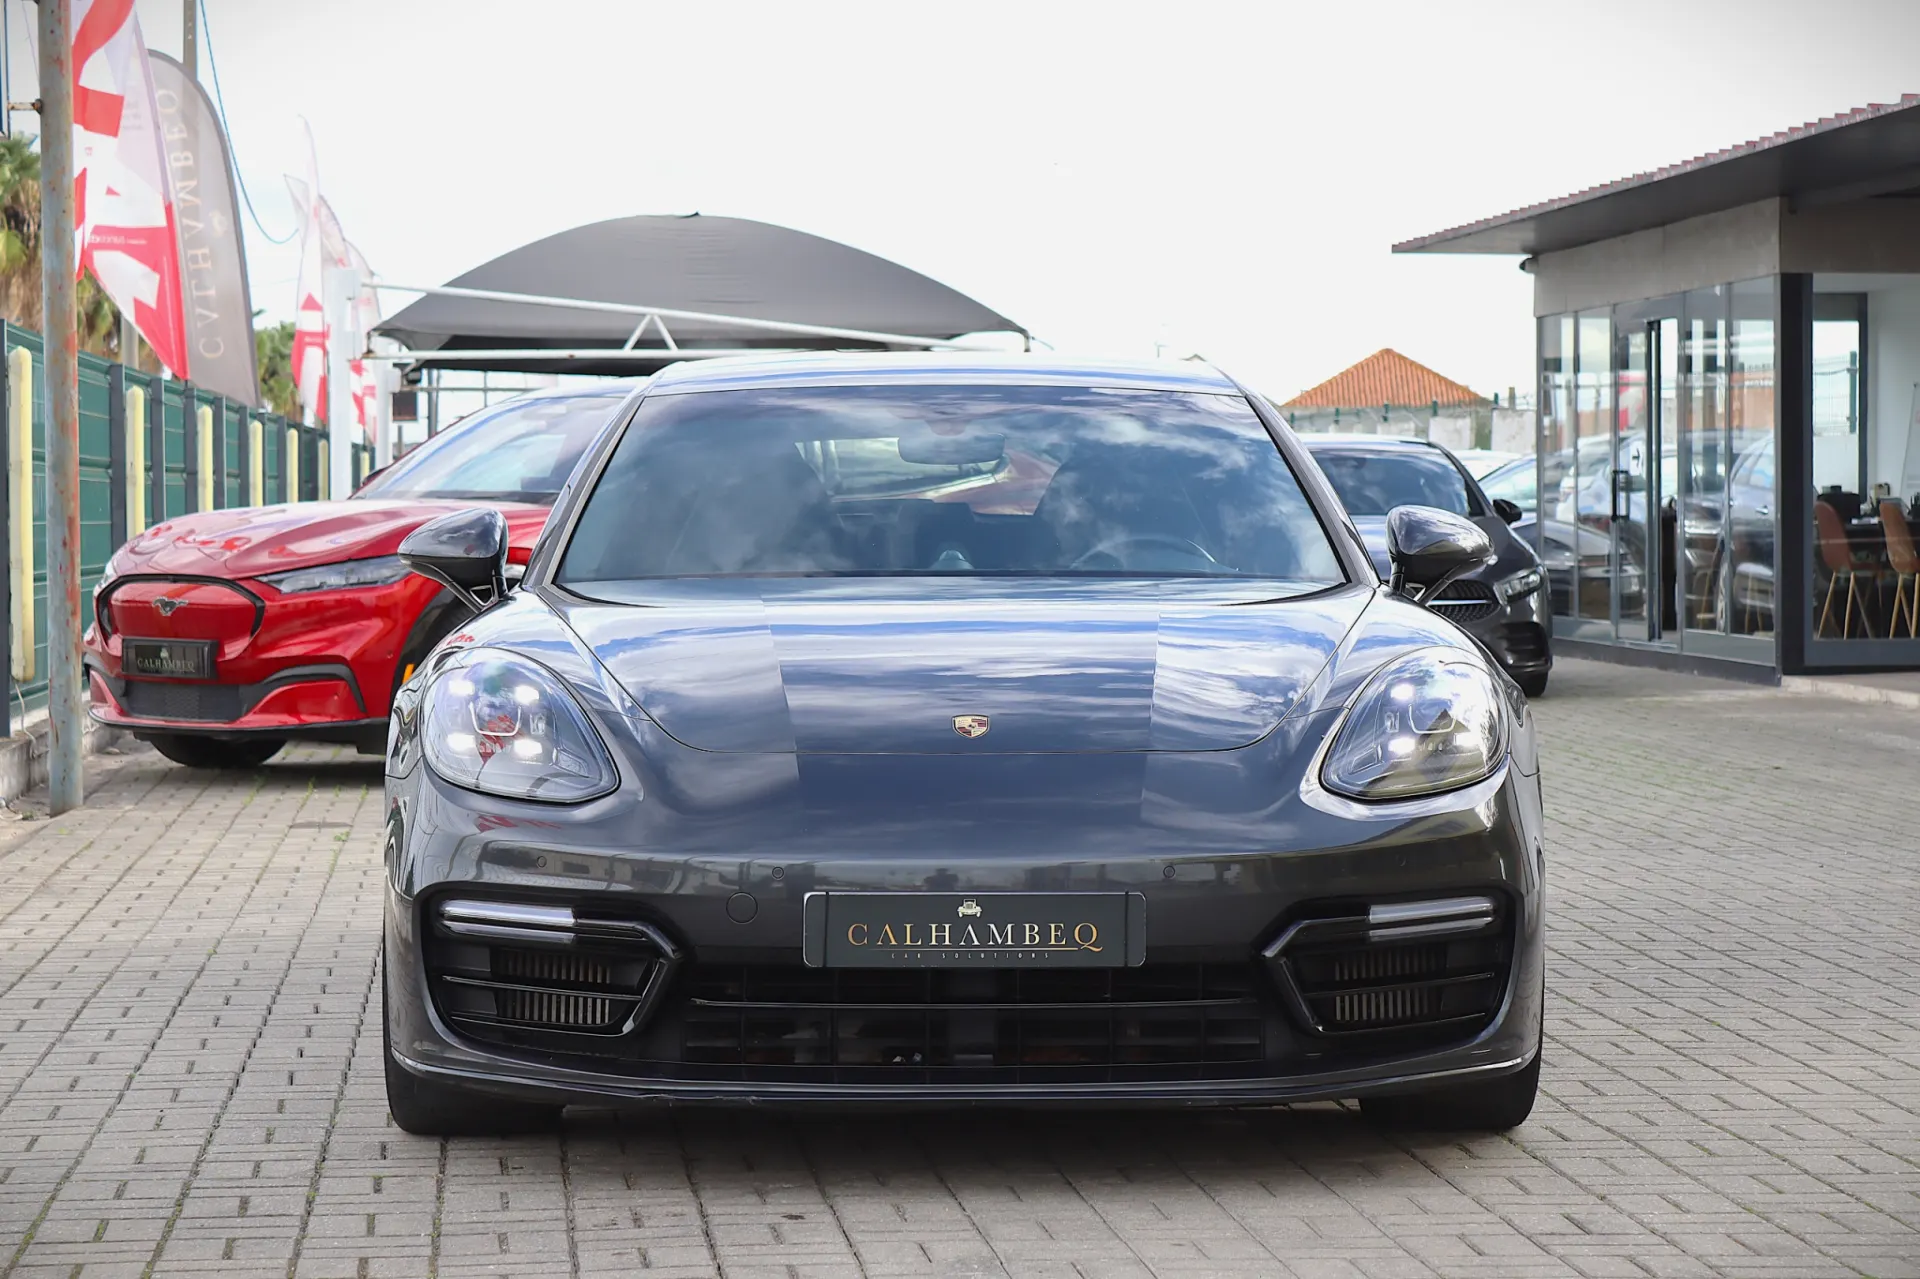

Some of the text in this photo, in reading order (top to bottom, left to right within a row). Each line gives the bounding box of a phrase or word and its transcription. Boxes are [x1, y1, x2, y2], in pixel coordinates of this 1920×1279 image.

[847, 922, 1103, 952] CALHAMBEQ
[891, 952, 1049, 960] CAR SOLUTIONS
